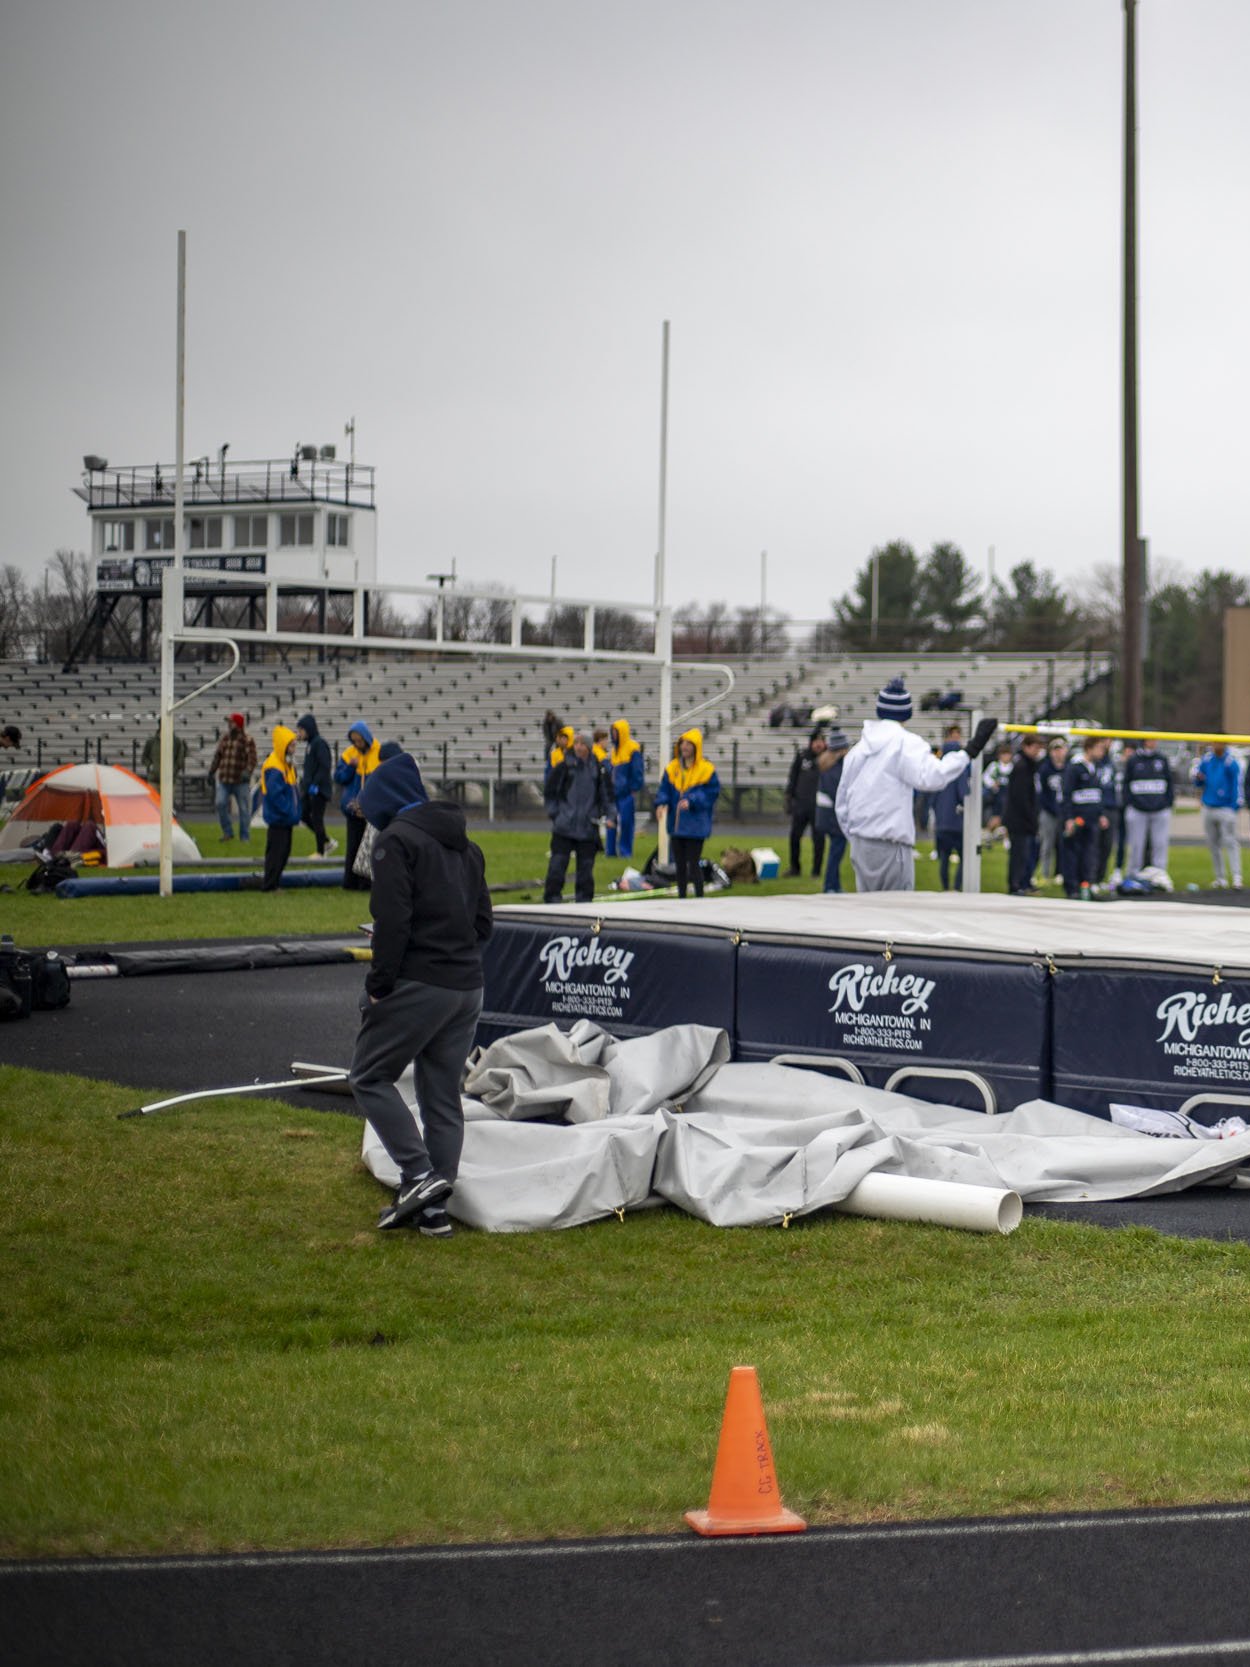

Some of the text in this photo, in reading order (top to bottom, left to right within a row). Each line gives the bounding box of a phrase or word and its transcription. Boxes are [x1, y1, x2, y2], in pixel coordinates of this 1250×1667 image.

[539, 936, 635, 985] Richey
[545, 981, 631, 1000] MICHIGANTOWN, IN
[828, 963, 936, 1015] Richey
[551, 1001, 623, 1017] RICHEYATHLETICS.COM
[562, 995, 613, 1006] 1-800-333-PITS
[835, 1011, 931, 1031] MICHIGANTOWN, IN
[842, 1033, 923, 1050] RICHEYATHLETICS.COM
[854, 1026, 912, 1039] 1-800-333-PITS
[1186, 1058, 1249, 1070] 1-800-333-PITS
[754, 1430, 769, 1472] TRACK
